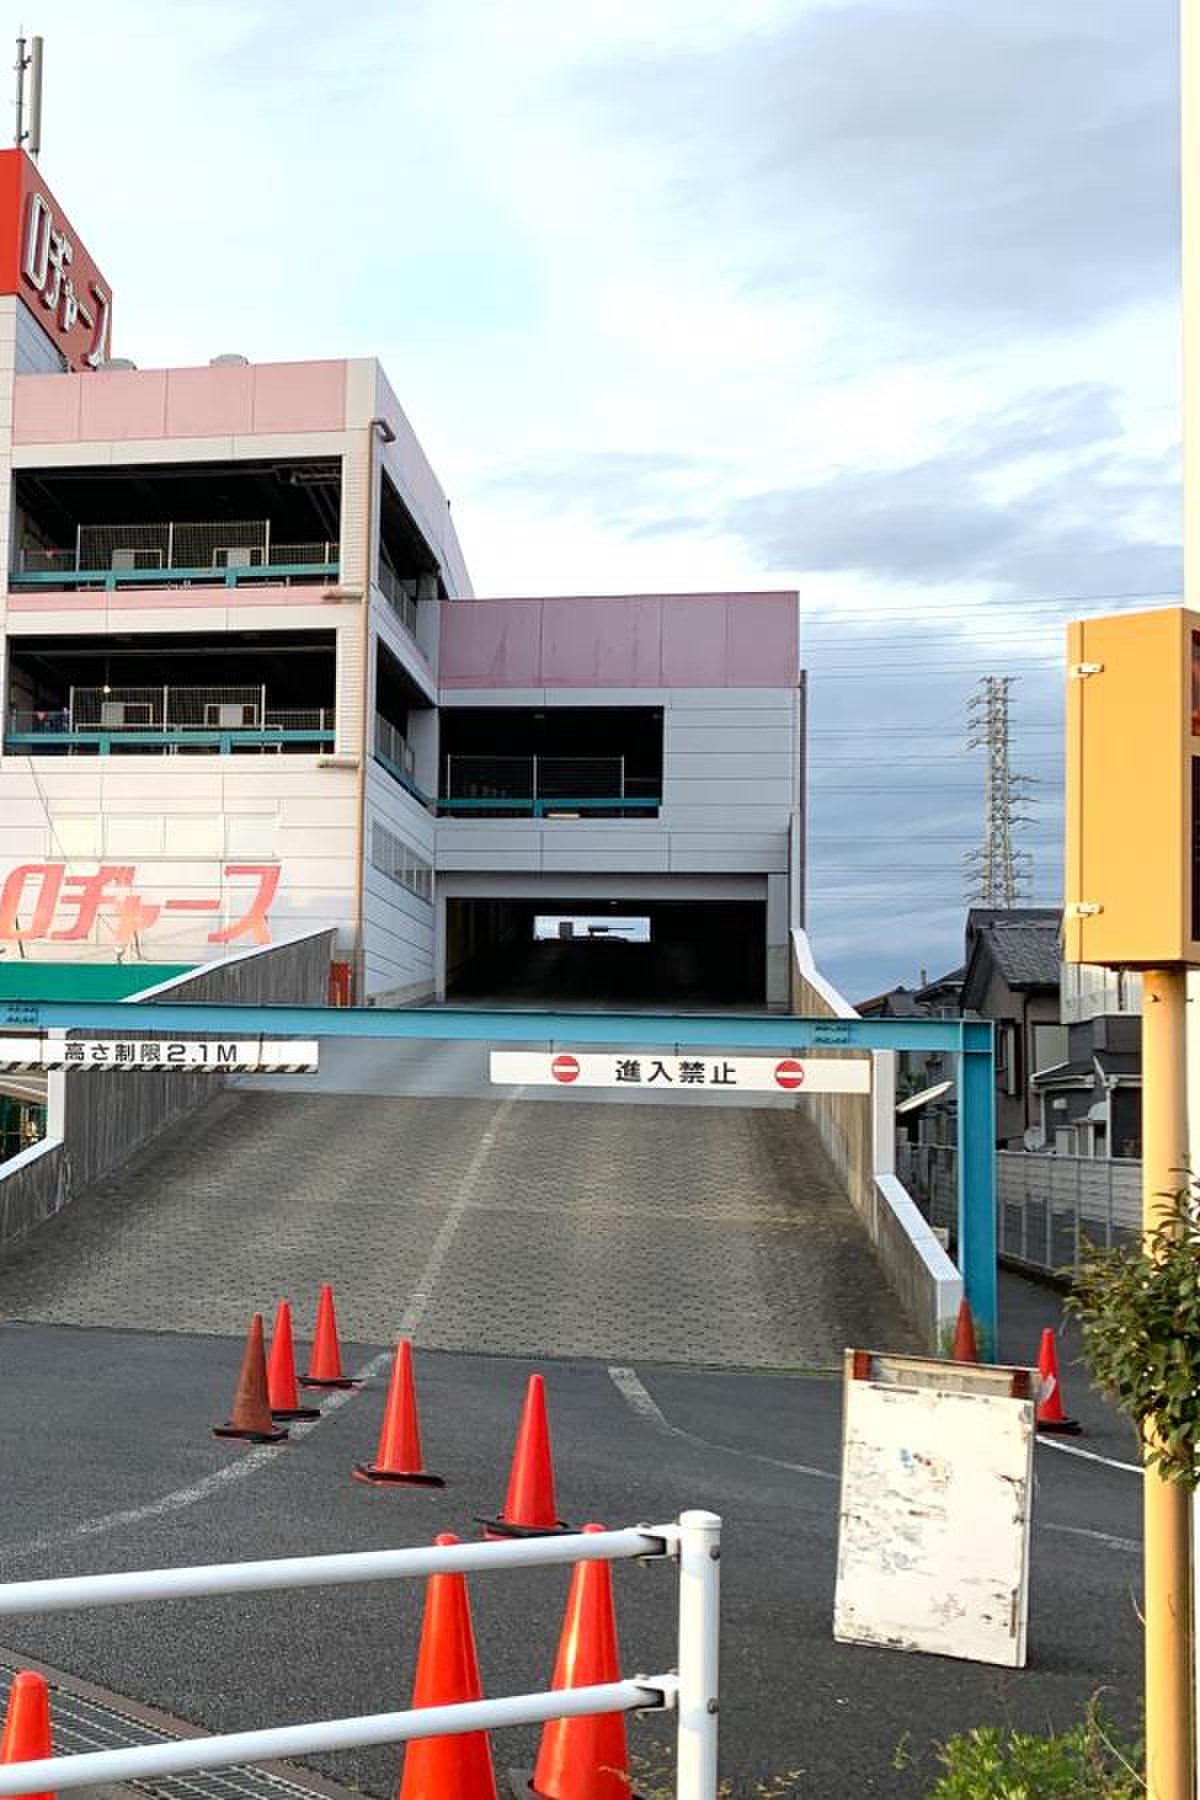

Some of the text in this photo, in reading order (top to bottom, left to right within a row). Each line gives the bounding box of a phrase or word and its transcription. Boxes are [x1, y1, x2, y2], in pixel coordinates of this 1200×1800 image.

[64, 1042, 238, 1063] 高さ制限2.1M
[615, 1059, 738, 1085] 進入禁止
